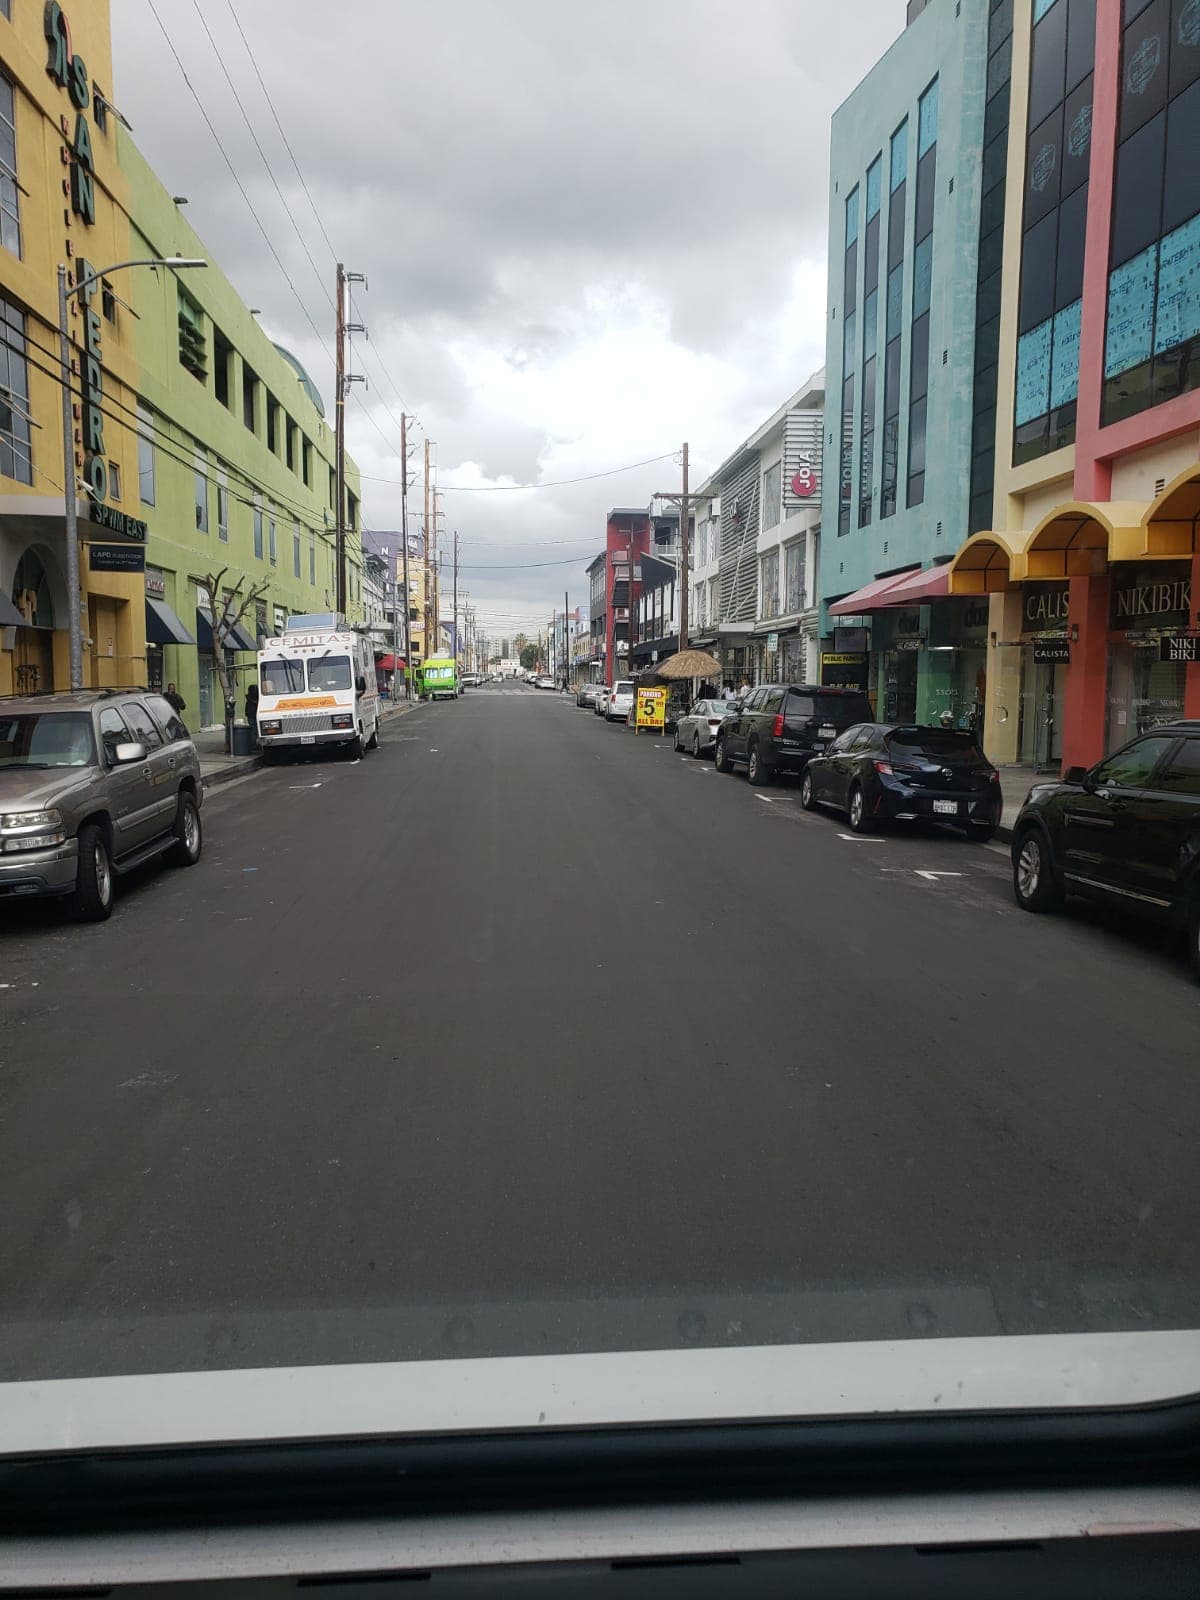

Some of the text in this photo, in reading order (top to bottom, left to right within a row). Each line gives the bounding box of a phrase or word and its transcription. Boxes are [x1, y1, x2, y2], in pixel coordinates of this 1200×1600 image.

[70, 54, 107, 502] SAN PEDRO
[799, 451, 811, 489] JOIA
[96, 503, 147, 541] SPWM EAS
[1026, 591, 1069, 620] CALIS
[1116, 581, 1191, 616] NIKIBIK
[269, 633, 351, 647] CEMITAS
[1169, 638, 1196, 649] NIKI
[1034, 650, 1069, 658] CALISTA
[1169, 649, 1196, 660] BIKI
[640, 690, 661, 698] PARKING
